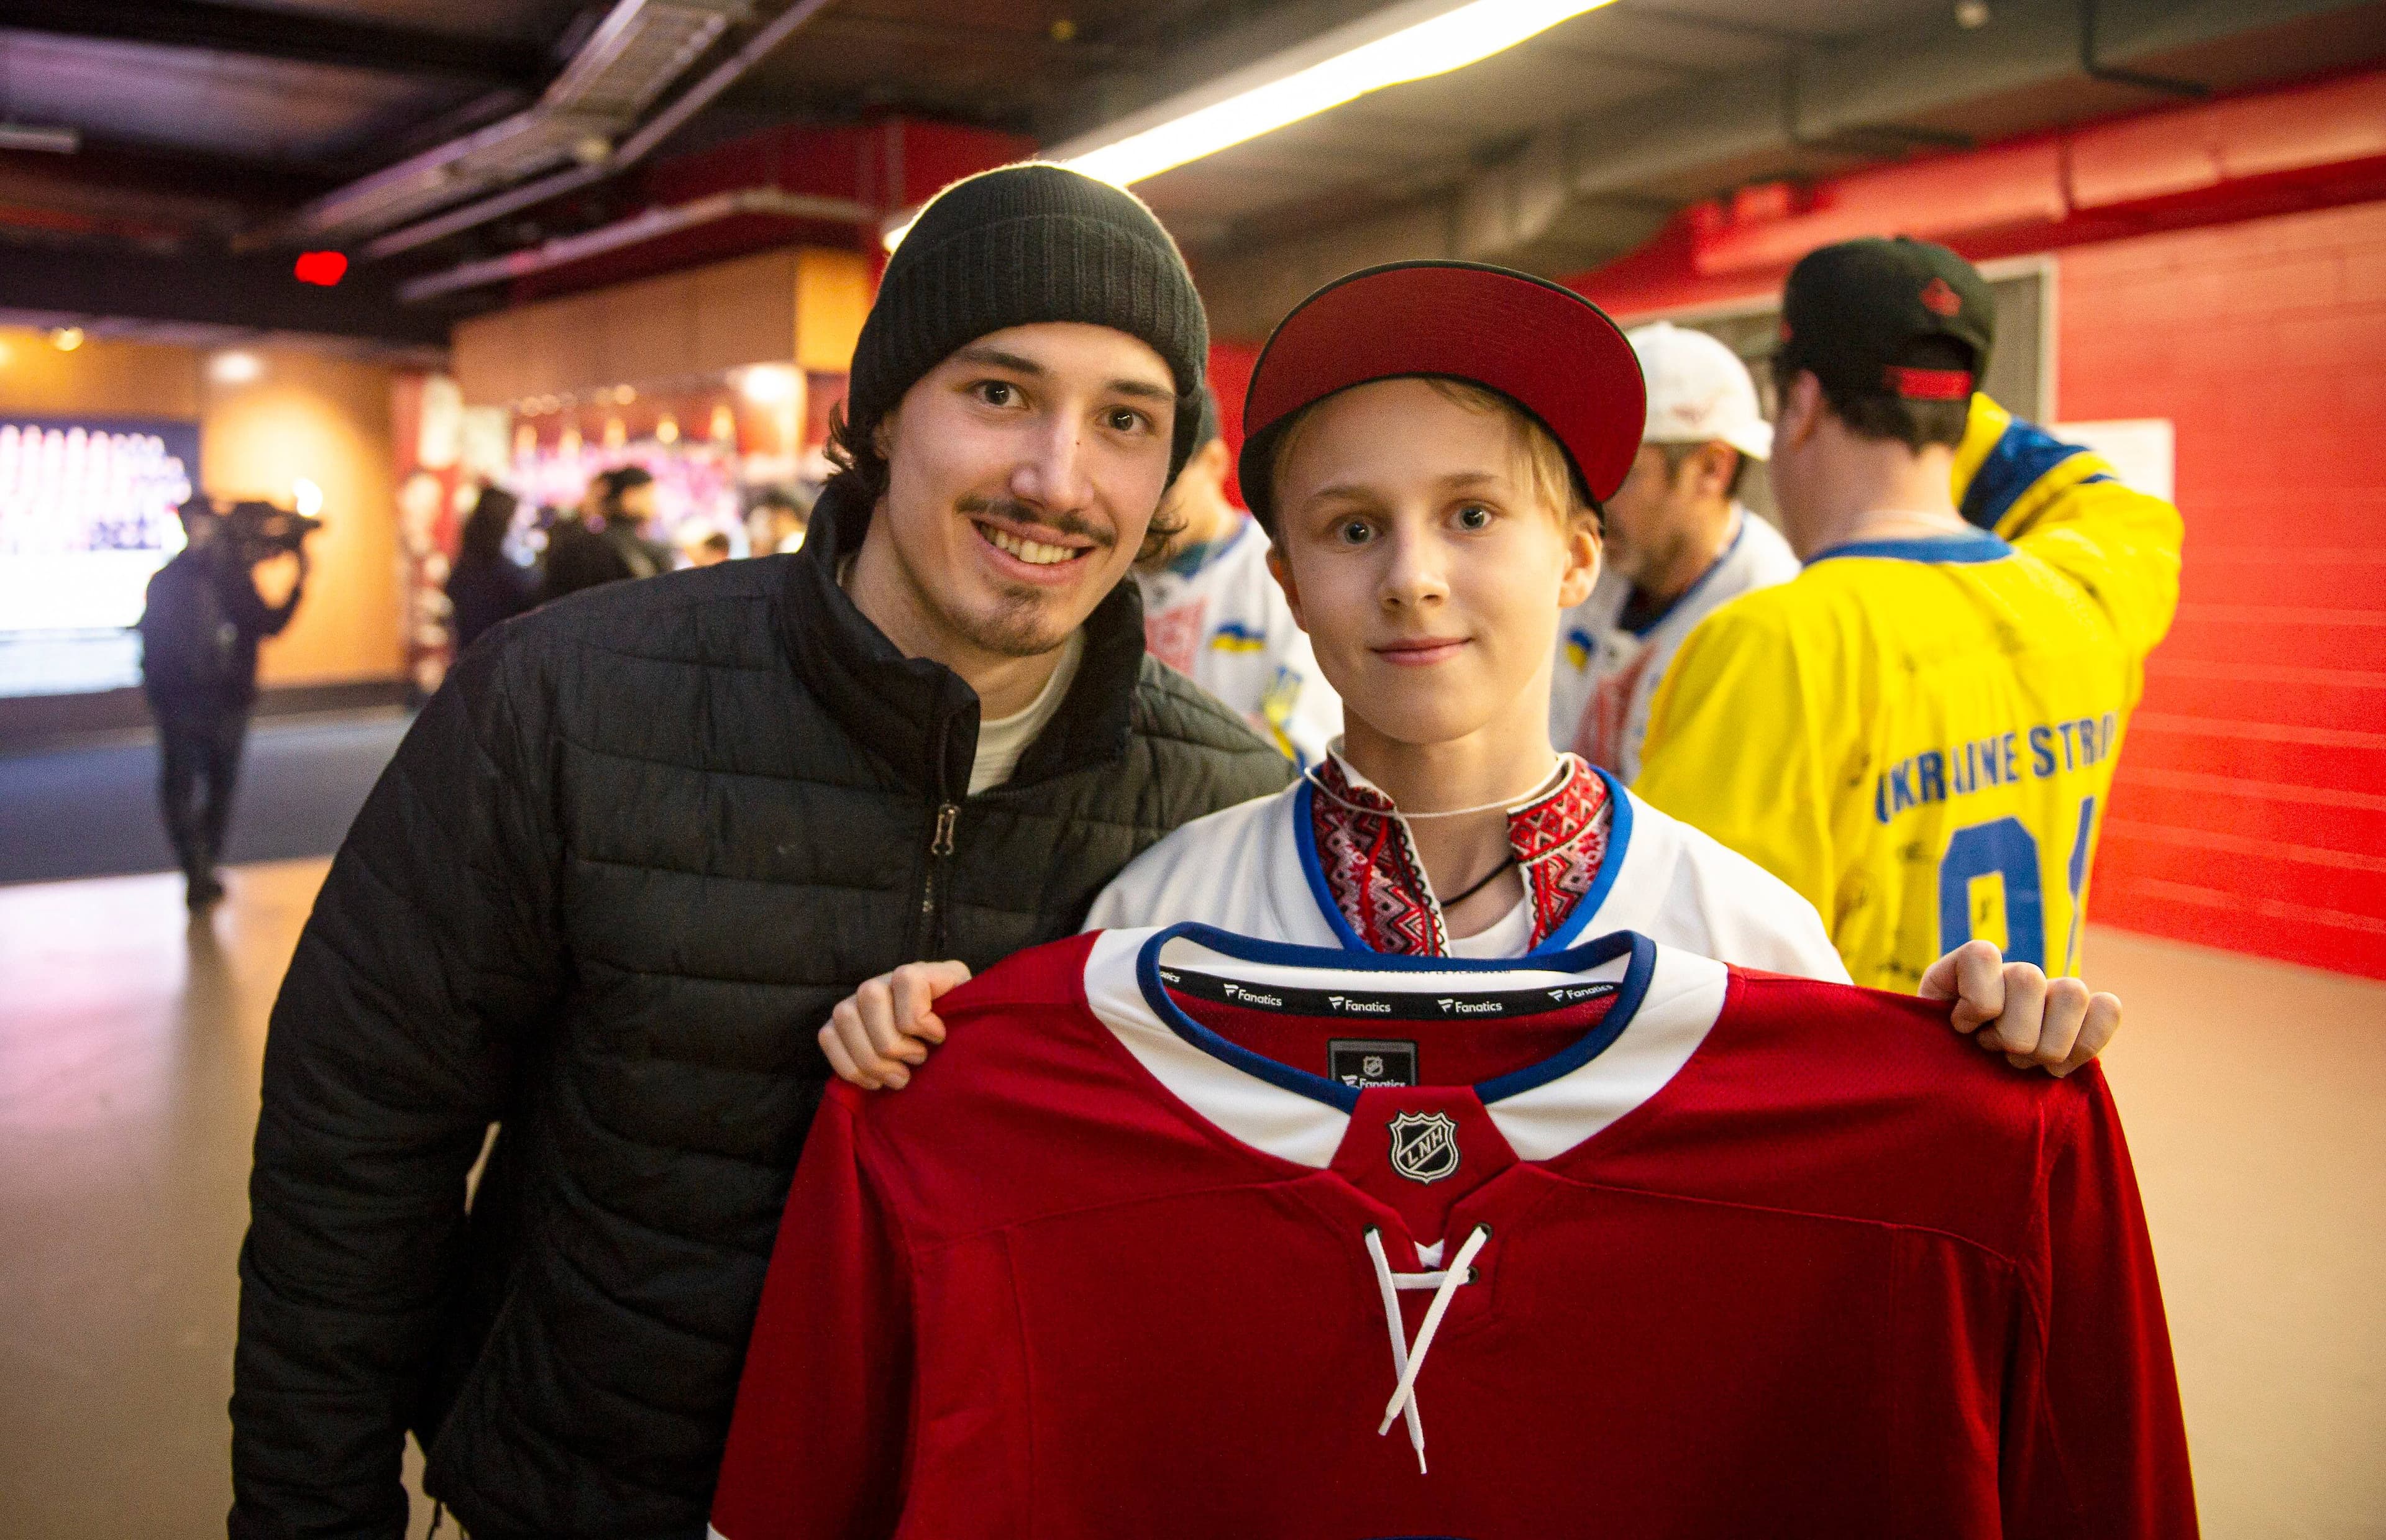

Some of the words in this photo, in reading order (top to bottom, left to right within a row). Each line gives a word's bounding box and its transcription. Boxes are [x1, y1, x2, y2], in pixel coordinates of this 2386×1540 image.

[1238, 989, 1282, 1006] Fanatics
[1345, 999, 1391, 1013] Fanatics
[1455, 1001, 1502, 1013] Fanatics
[1565, 984, 1614, 1000] Fanatics
[1407, 1126, 1443, 1167] LNH
